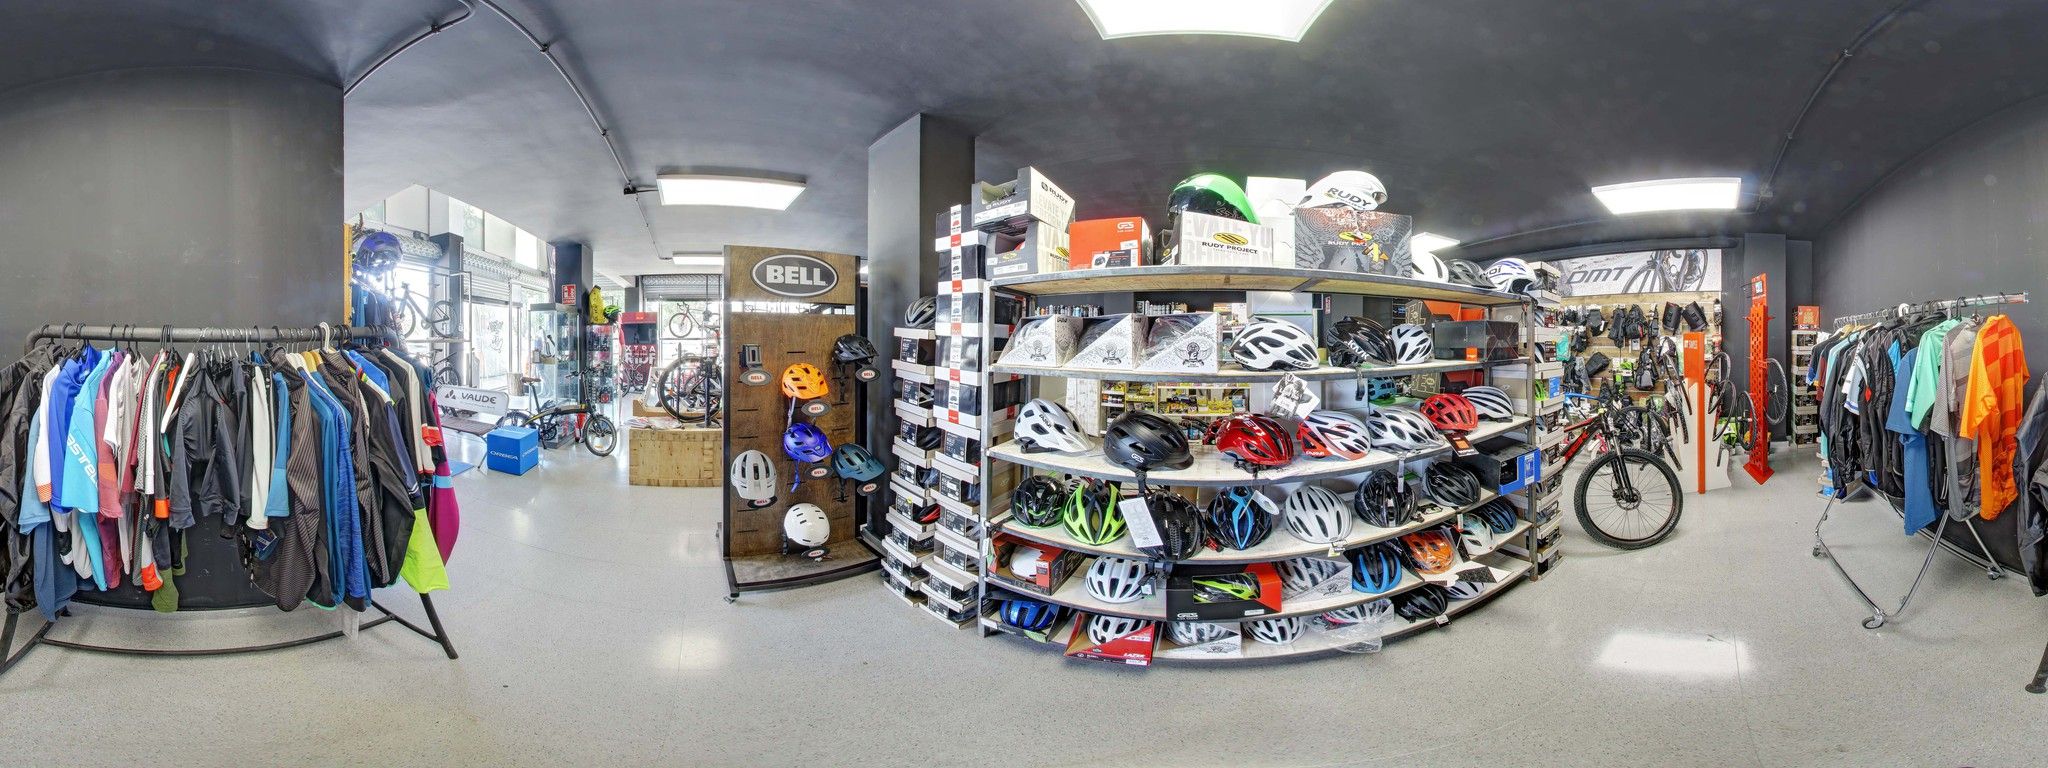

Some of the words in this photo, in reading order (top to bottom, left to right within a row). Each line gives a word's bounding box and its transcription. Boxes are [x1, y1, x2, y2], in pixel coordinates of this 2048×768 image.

[1328, 187, 1372, 207] RUDY
[1201, 241, 1225, 249] RUDY
[1226, 244, 1258, 255] PROJECT
[766, 264, 828, 287] BELL
[1565, 266, 1633, 285] DMT
[1292, 360, 1313, 369] LAZER
[461, 392, 498, 405] VAUDE
[490, 450, 519, 461] ORBEA
